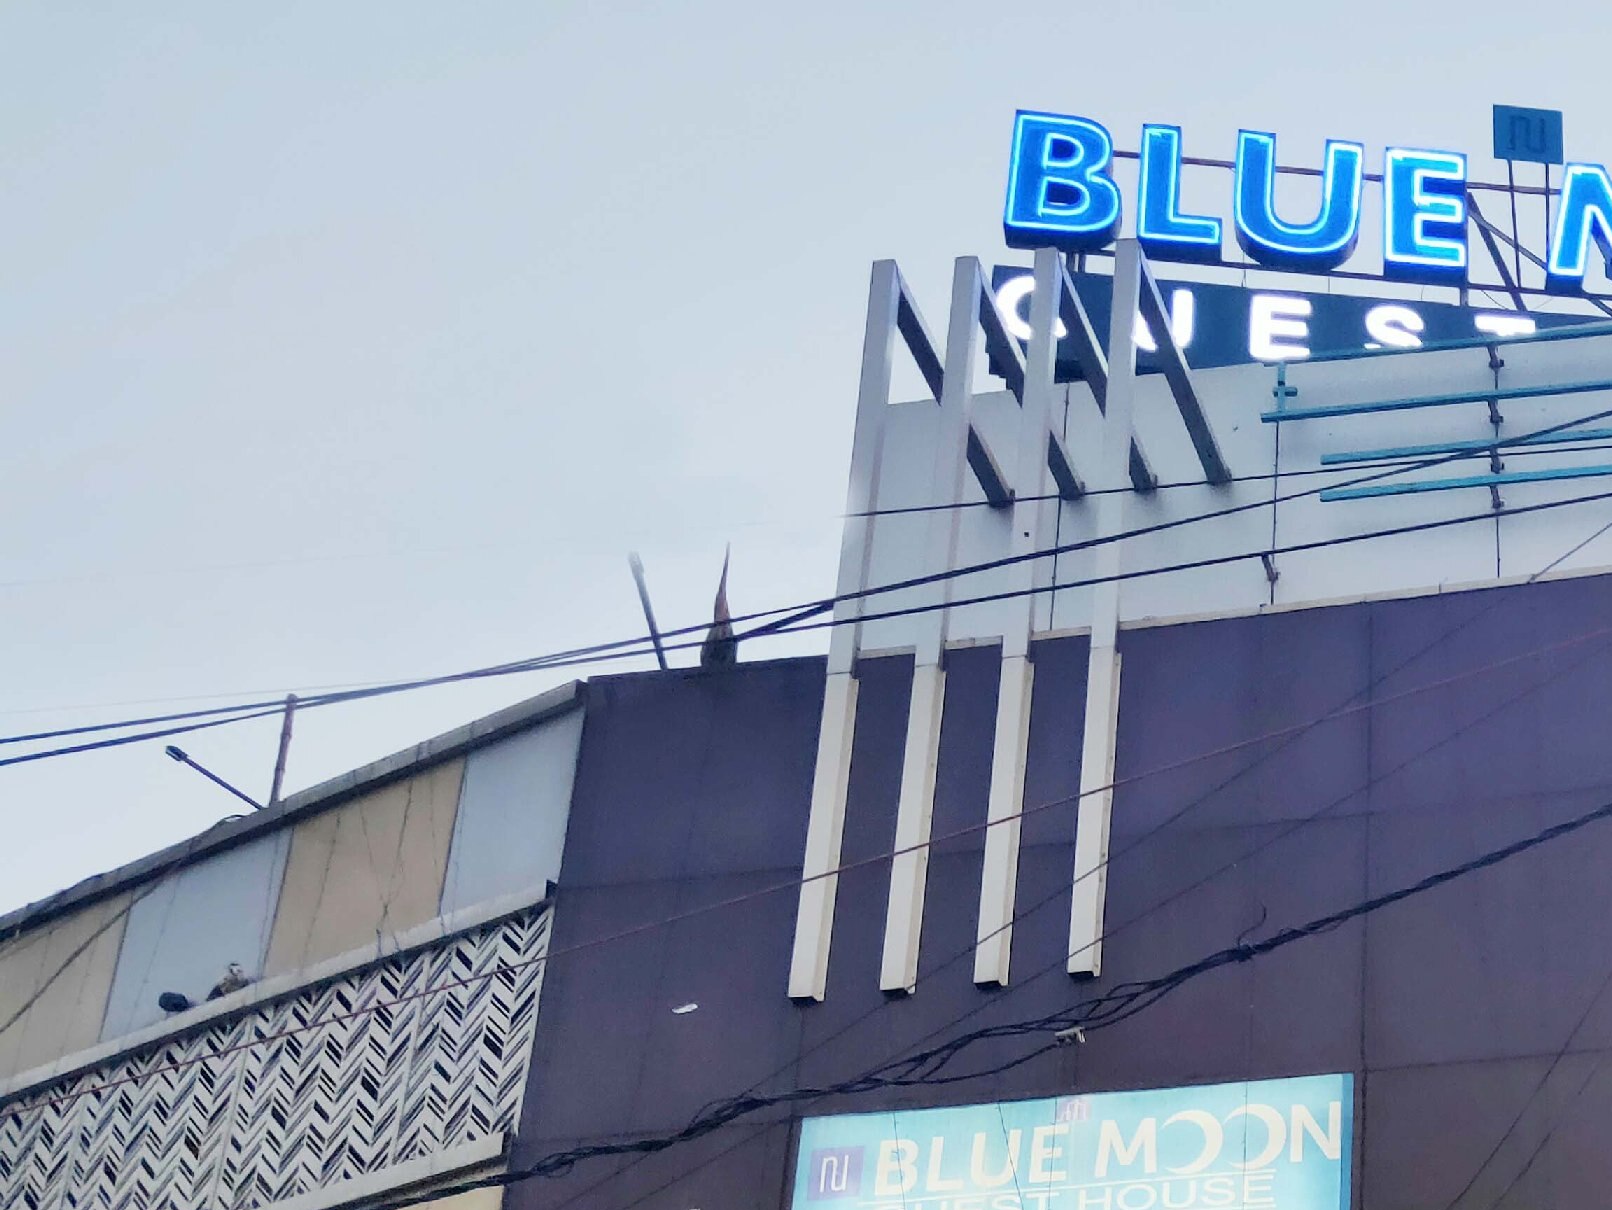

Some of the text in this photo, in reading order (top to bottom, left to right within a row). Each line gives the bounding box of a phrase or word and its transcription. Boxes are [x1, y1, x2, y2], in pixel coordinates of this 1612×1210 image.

[1004, 109, 1467, 286] BLUE
[873, 1100, 1341, 1198] BLUE MOON
